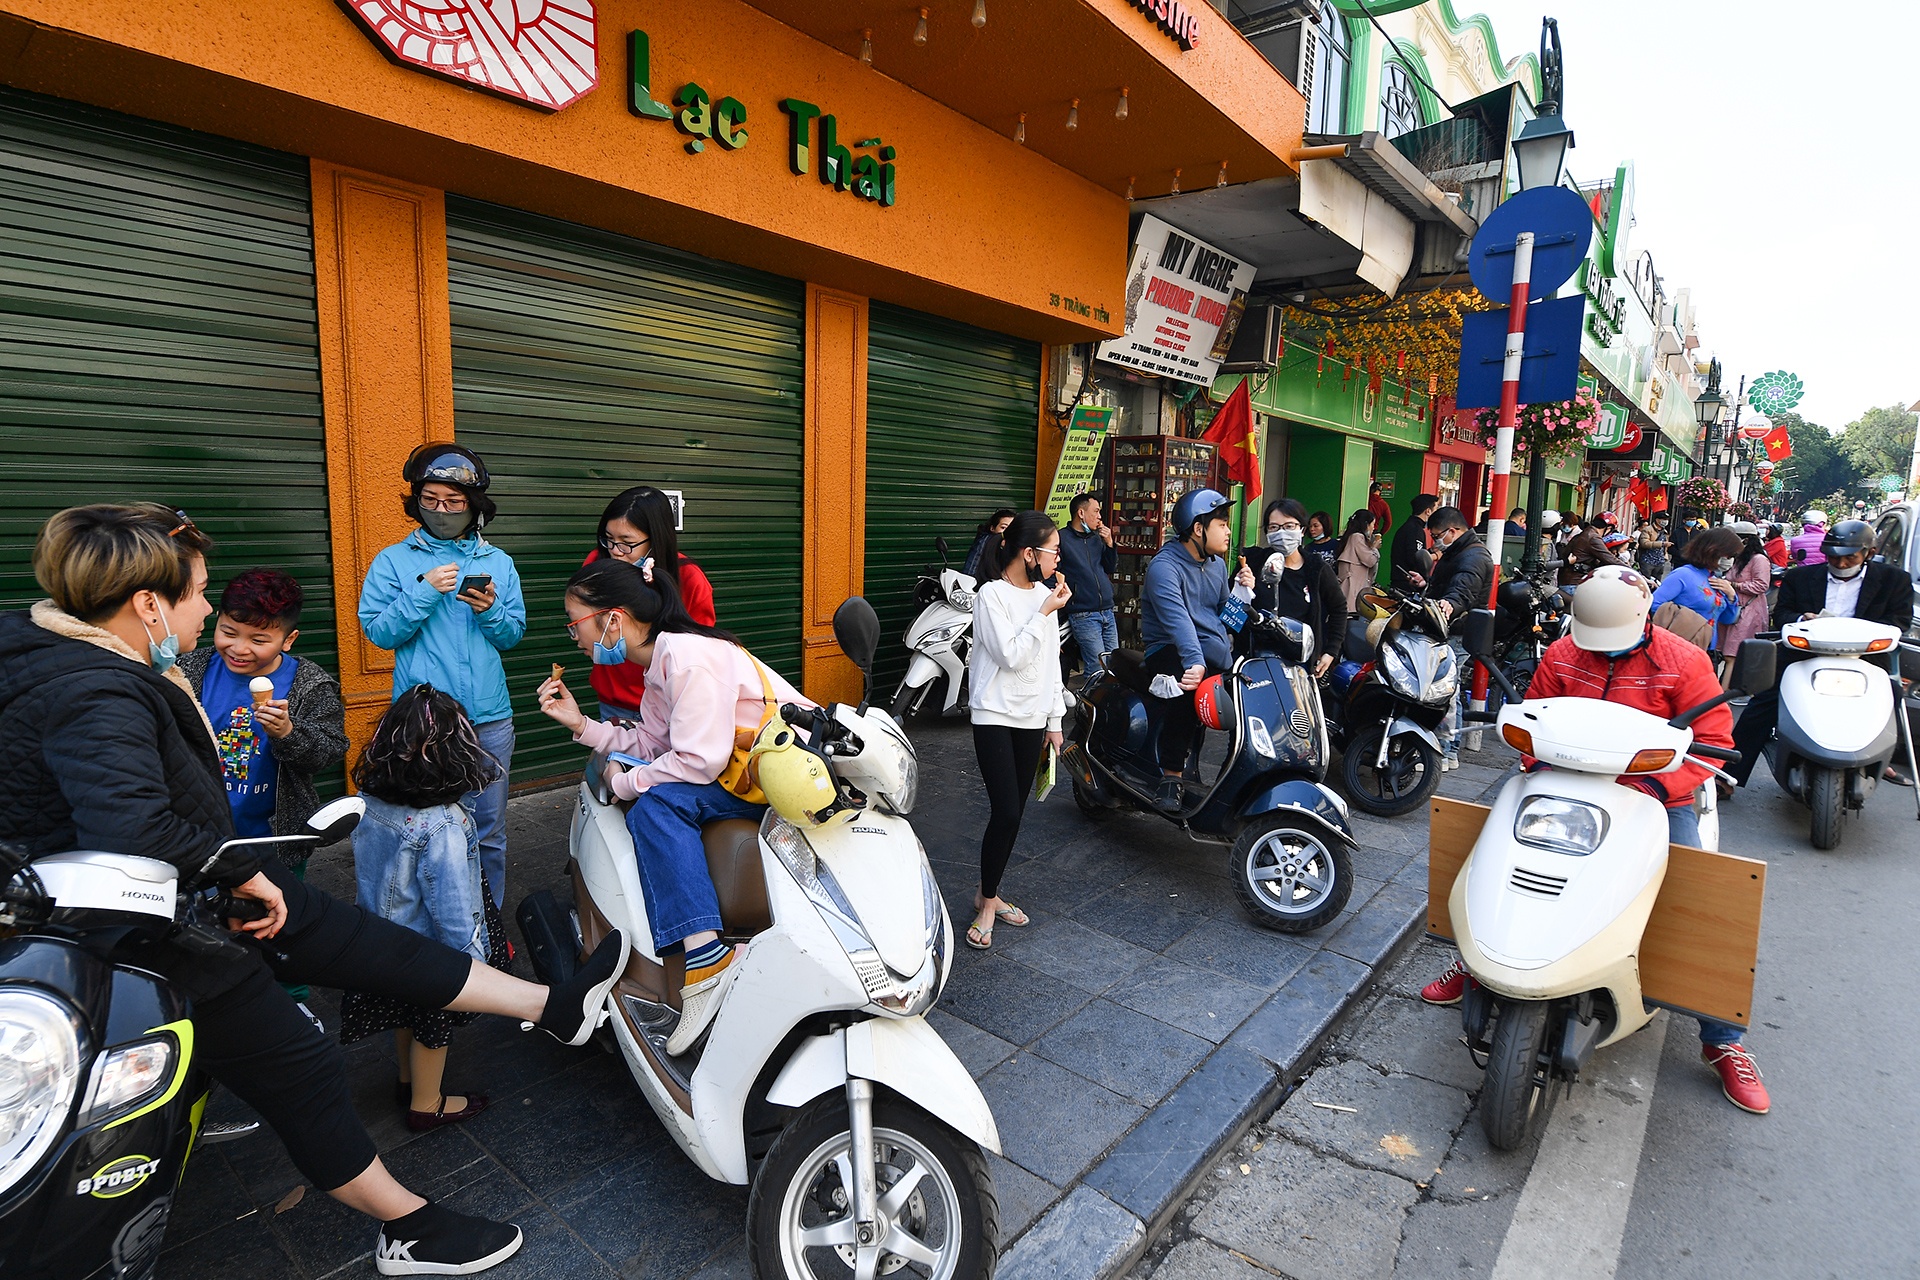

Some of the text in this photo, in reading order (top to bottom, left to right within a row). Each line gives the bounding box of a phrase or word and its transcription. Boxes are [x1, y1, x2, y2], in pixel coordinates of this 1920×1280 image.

[627, 28, 896, 207] Lạc Thái
[1157, 231, 1239, 293] MY NGHE
[1049, 293, 1109, 324] 33 TRÀNG TIỀN
[1145, 276, 1228, 327] PHUONG DONG
[1131, 342, 1138, 350] 33
[1108, 351, 1121, 361] OPEN
[1142, 360, 1156, 370] CLOSE
[1055, 483, 1076, 493] KEM QUE
[238, 783, 249, 795] IT
[254, 783, 269, 794] UP
[121, 891, 165, 902] HONDA
[76, 1158, 161, 1195] SPORTY
